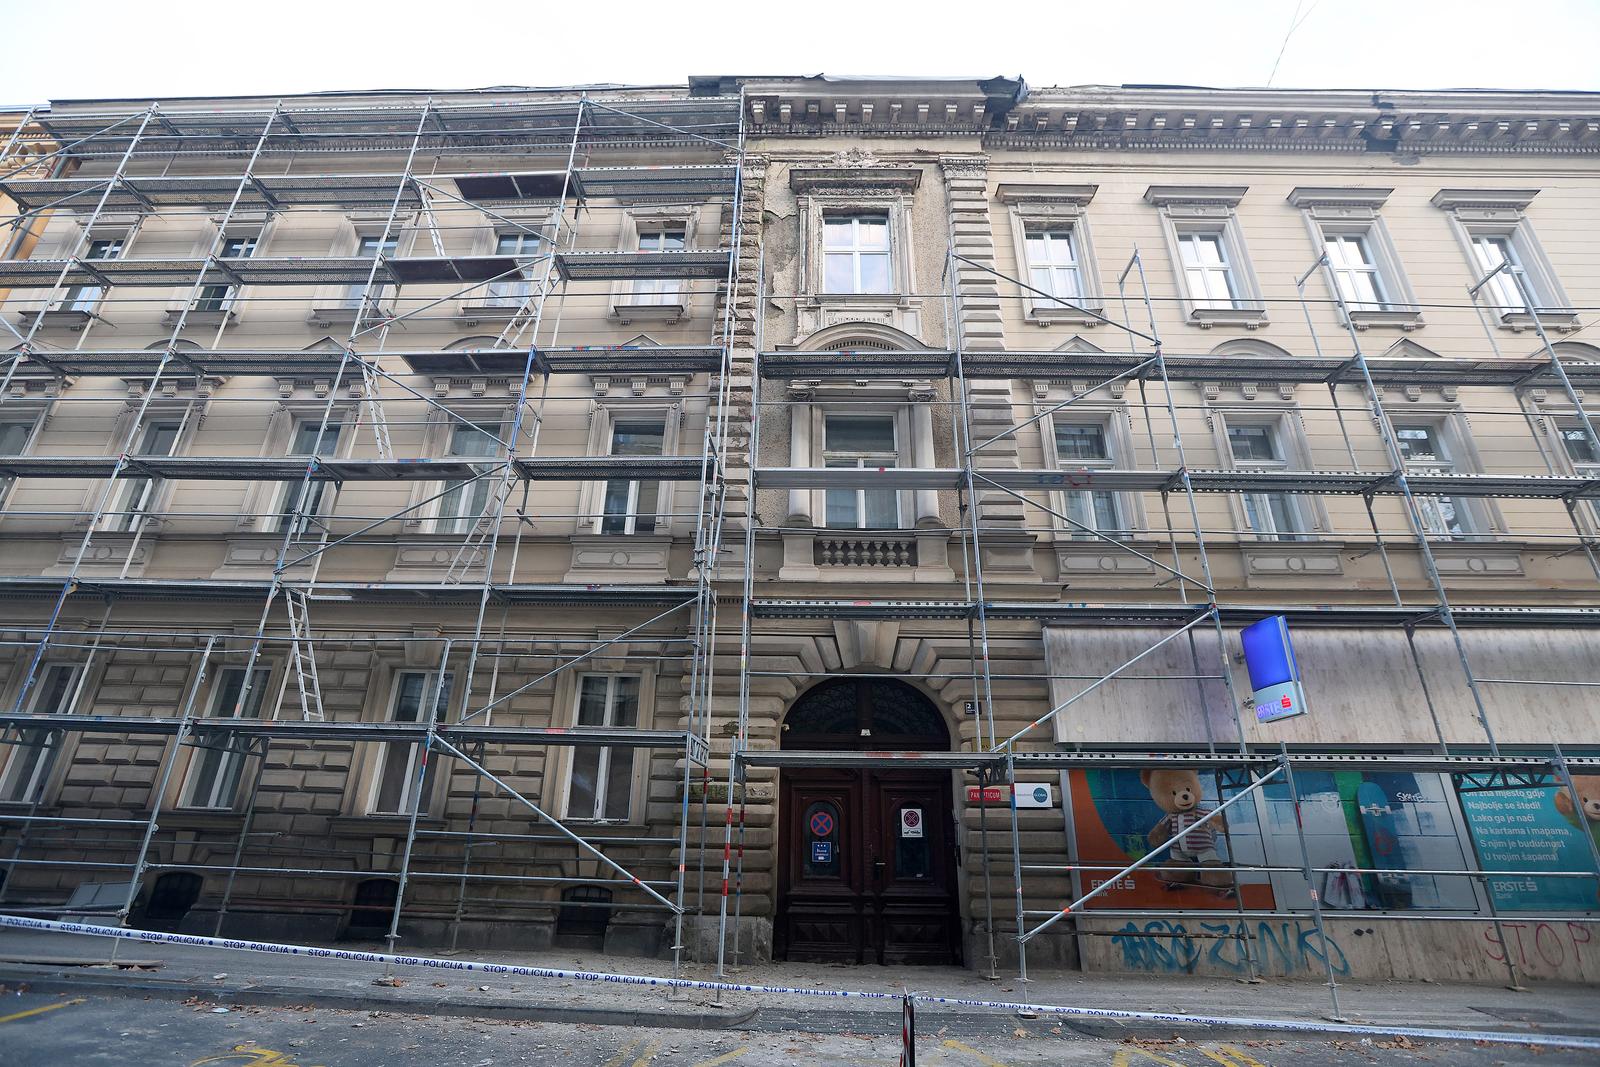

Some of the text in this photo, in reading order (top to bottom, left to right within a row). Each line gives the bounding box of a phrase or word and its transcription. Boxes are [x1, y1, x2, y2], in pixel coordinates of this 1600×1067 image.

[1526, 788, 1545, 798] gdje
[1468, 802, 1504, 810] Najbolje
[1506, 814, 1515, 822] je
[1490, 827, 1526, 835] kartama
[1488, 840, 1507, 848] njim
[1508, 840, 1517, 848] je
[1492, 853, 1520, 862] tvojim
[1492, 882, 1526, 892] ERSTE
[1484, 921, 1590, 968] STOP
[6, 918, 42, 928] POLICIJA
[60, 924, 82, 932] STOP
[86, 927, 122, 936] POLICIJA
[140, 932, 162, 940] STOP
[167, 936, 205, 945] POLICIJA
[224, 940, 246, 949] STOP
[250, 944, 289, 954] POLICIJA
[308, 949, 330, 958] STOP
[336, 952, 376, 962] POLICIJA
[394, 957, 418, 966] STOP
[424, 960, 464, 970] POLICIJA
[484, 966, 507, 974] STOP
[512, 968, 554, 978] POLICIJA
[574, 972, 598, 981] STOP
[604, 975, 646, 985] POLICIJA
[698, 982, 741, 990] POLICIJA
